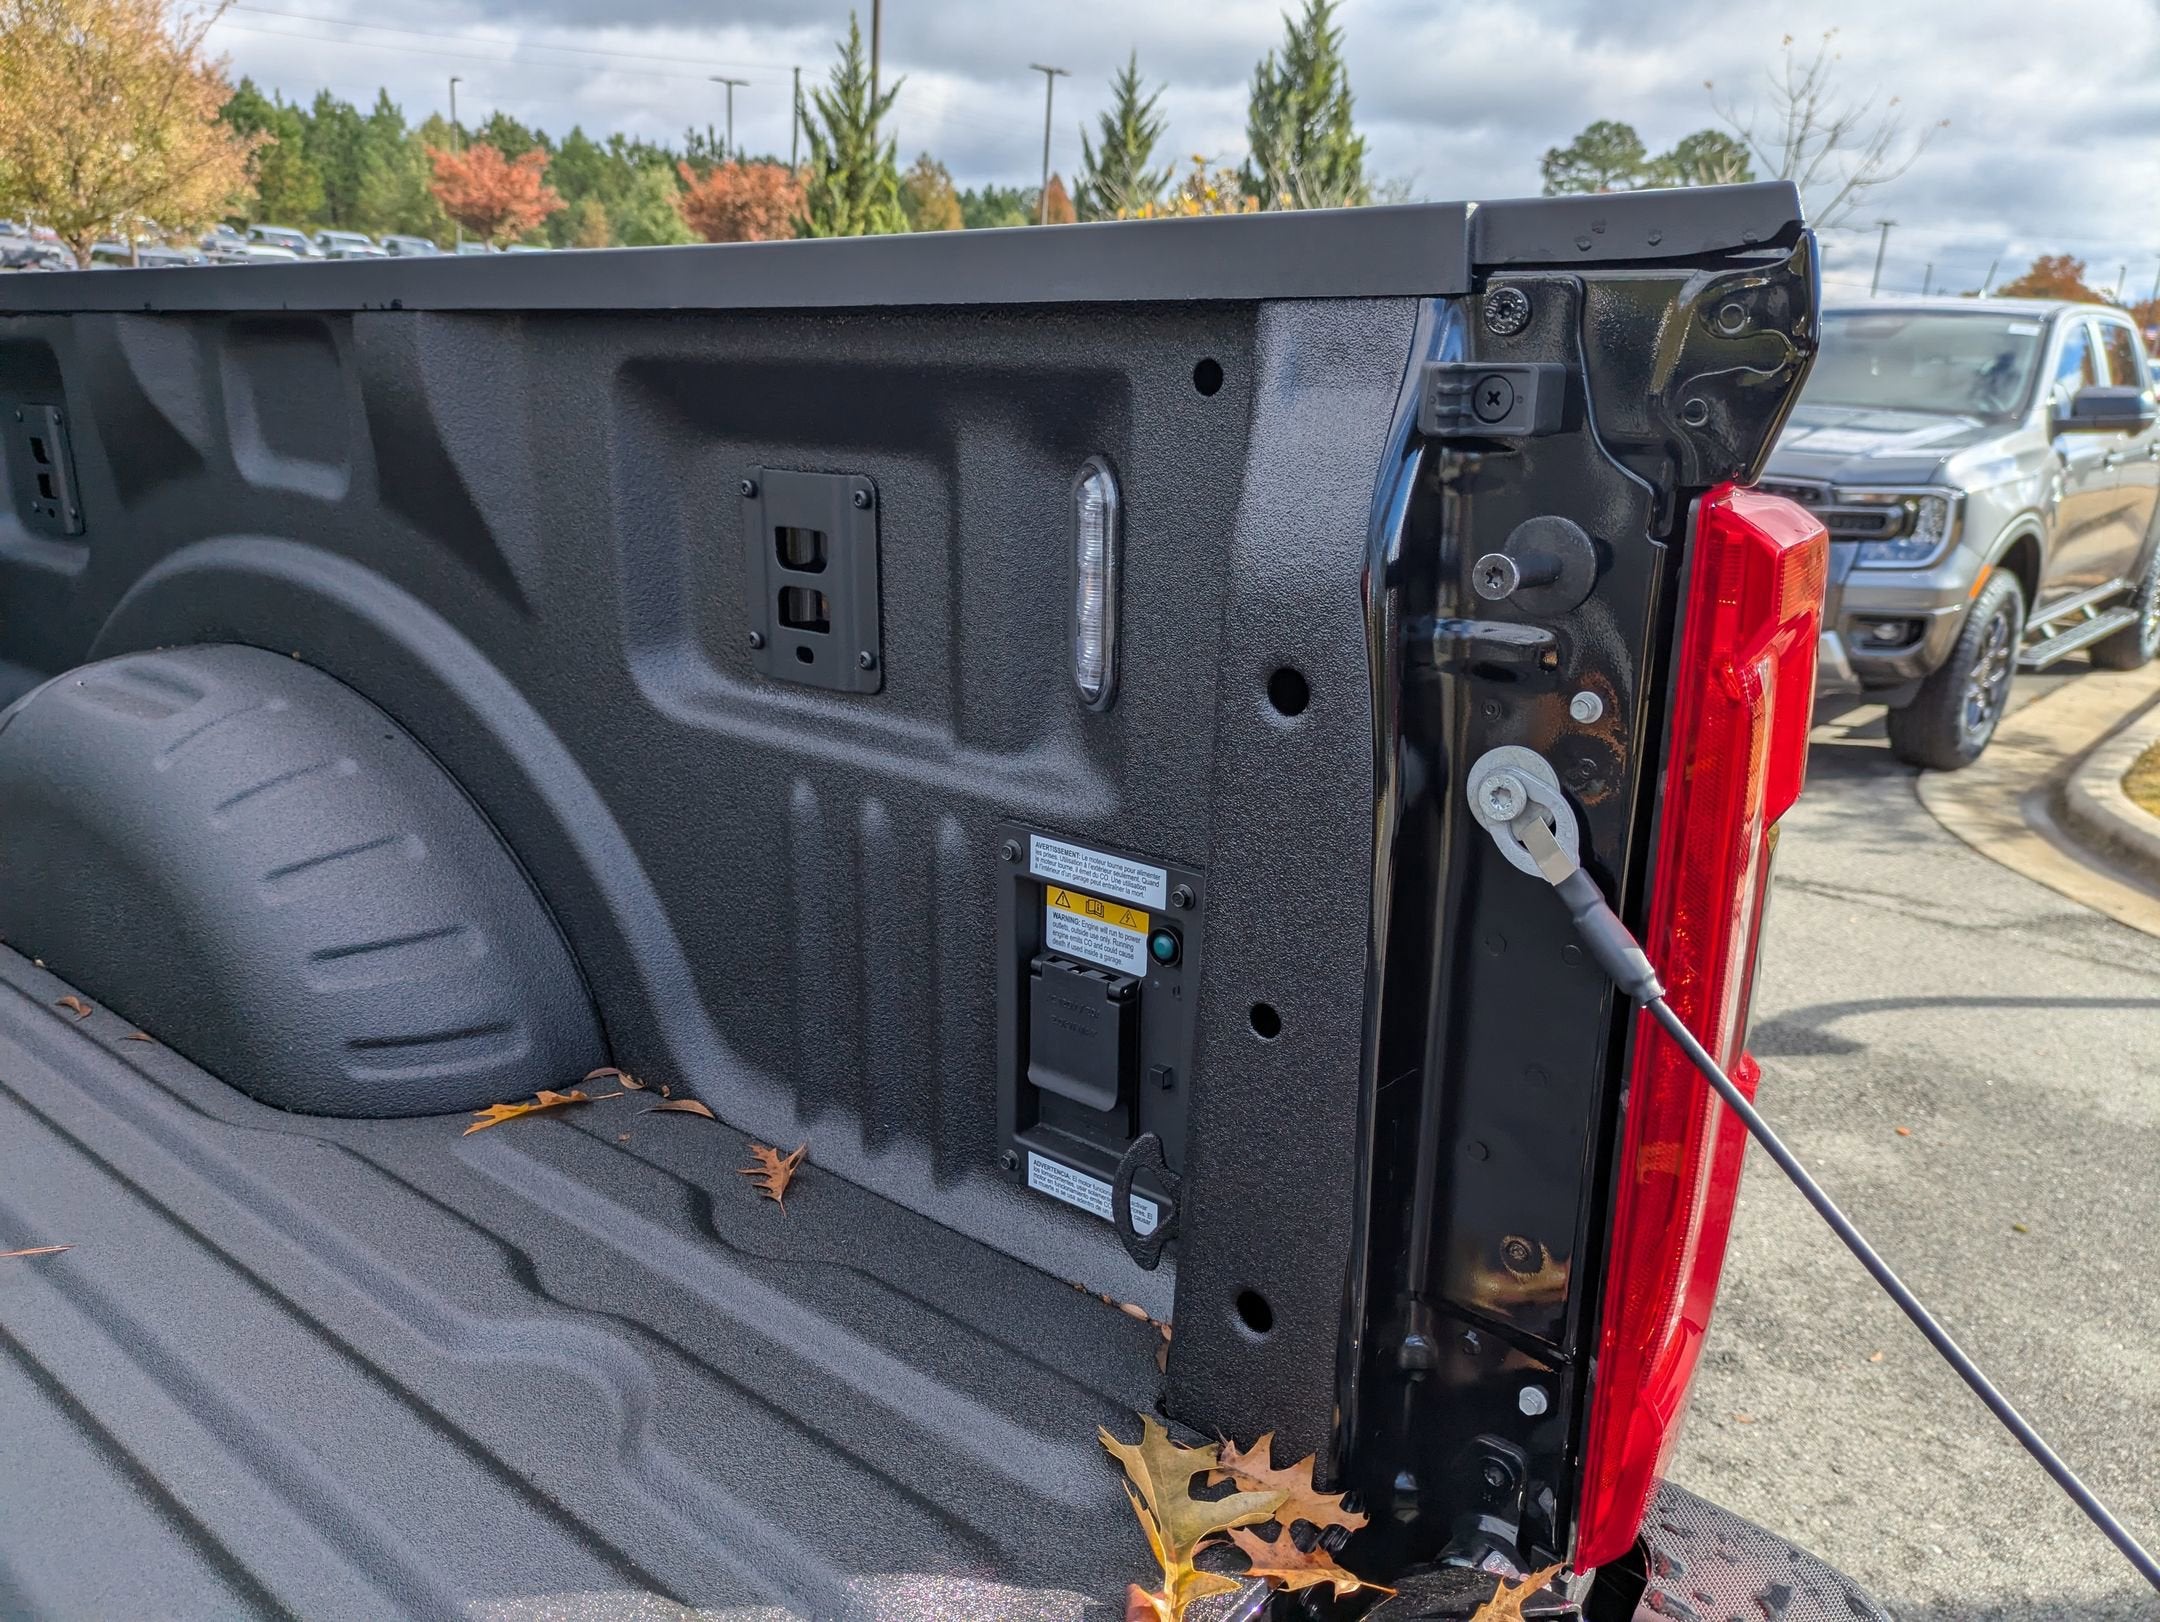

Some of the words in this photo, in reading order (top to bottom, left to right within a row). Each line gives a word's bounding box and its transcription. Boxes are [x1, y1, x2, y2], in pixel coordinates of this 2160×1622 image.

[1036, 841, 1080, 859] AVERTISSEMENT:
[1089, 856, 1105, 866] moteur
[1124, 867, 1136, 875] pour
[1041, 857, 1057, 867] moteur
[1111, 876, 1121, 885] Une
[1123, 880, 1146, 892] utilisation
[1072, 874, 1089, 884] garage
[1090, 878, 1101, 888] peut
[1142, 877, 1159, 888] Quand
[1053, 911, 1080, 926] WARNING:
[1082, 920, 1098, 933] Engine
[1100, 925, 1108, 934] will
[1125, 934, 1140, 945] power
[1071, 926, 1088, 937] outside
[1113, 938, 1134, 953] Running
[1053, 930, 1068, 941] engine
[1084, 938, 1092, 947] CO
[1094, 941, 1103, 950] and
[1104, 944, 1117, 955] could
[1119, 950, 1134, 960] cause
[1071, 943, 1083, 953] used
[1084, 947, 1098, 958] inside
[1034, 1159, 1071, 1180] ADVERTENCIA:
[1072, 1175, 1077, 1183] El
[1079, 1178, 1092, 1189] motor
[1034, 1172, 1046, 1182] motor
[1147, 1212, 1152, 1220] El
